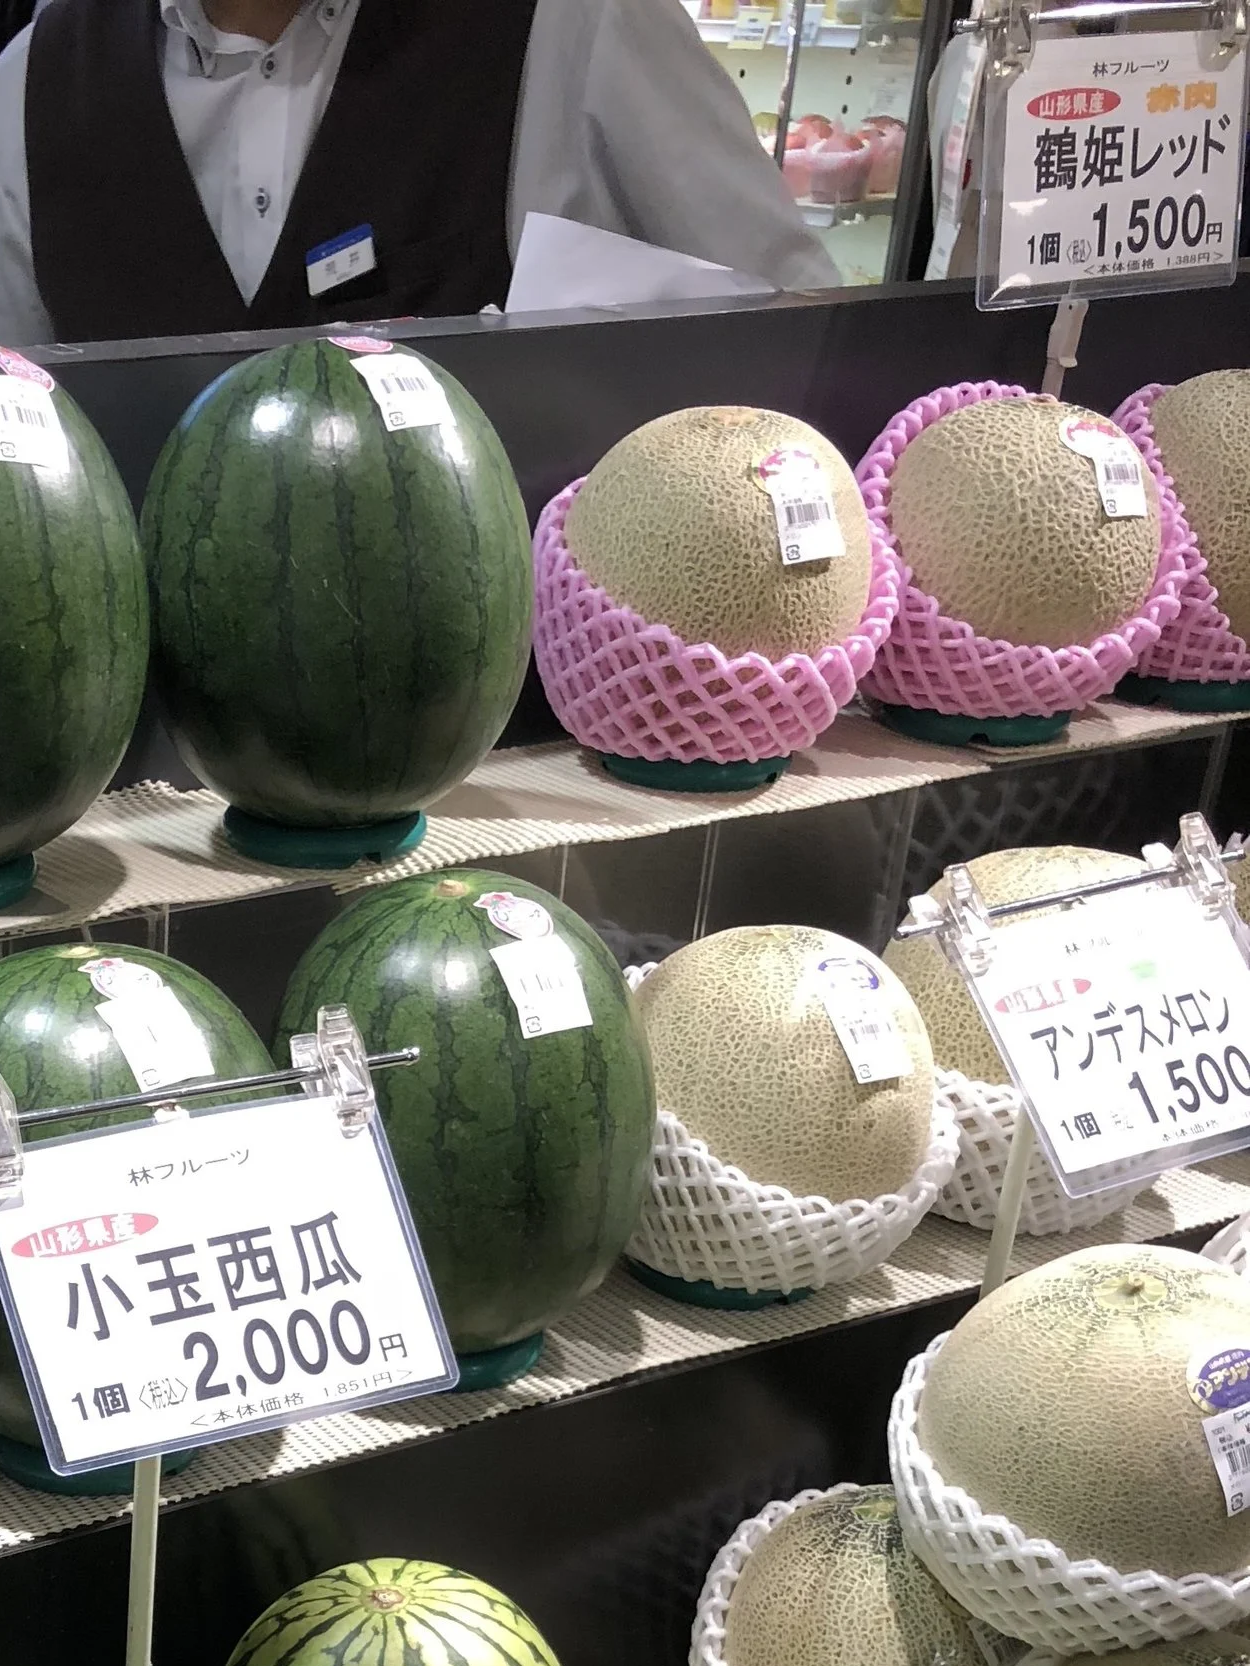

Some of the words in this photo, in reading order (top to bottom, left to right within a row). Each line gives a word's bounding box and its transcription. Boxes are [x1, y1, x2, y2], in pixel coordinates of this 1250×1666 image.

[1092, 59, 1170, 77] 林フルーツ
[1039, 92, 1105, 117] 山形県産
[1034, 114, 1231, 193] 鶴姫レッド
[1030, 989, 1229, 1081] アンデスメロン
[127, 1148, 251, 1187] 林フルーツ
[30, 1213, 138, 1257] 山形県産
[66, 1211, 363, 1342] 小玉西瓜
